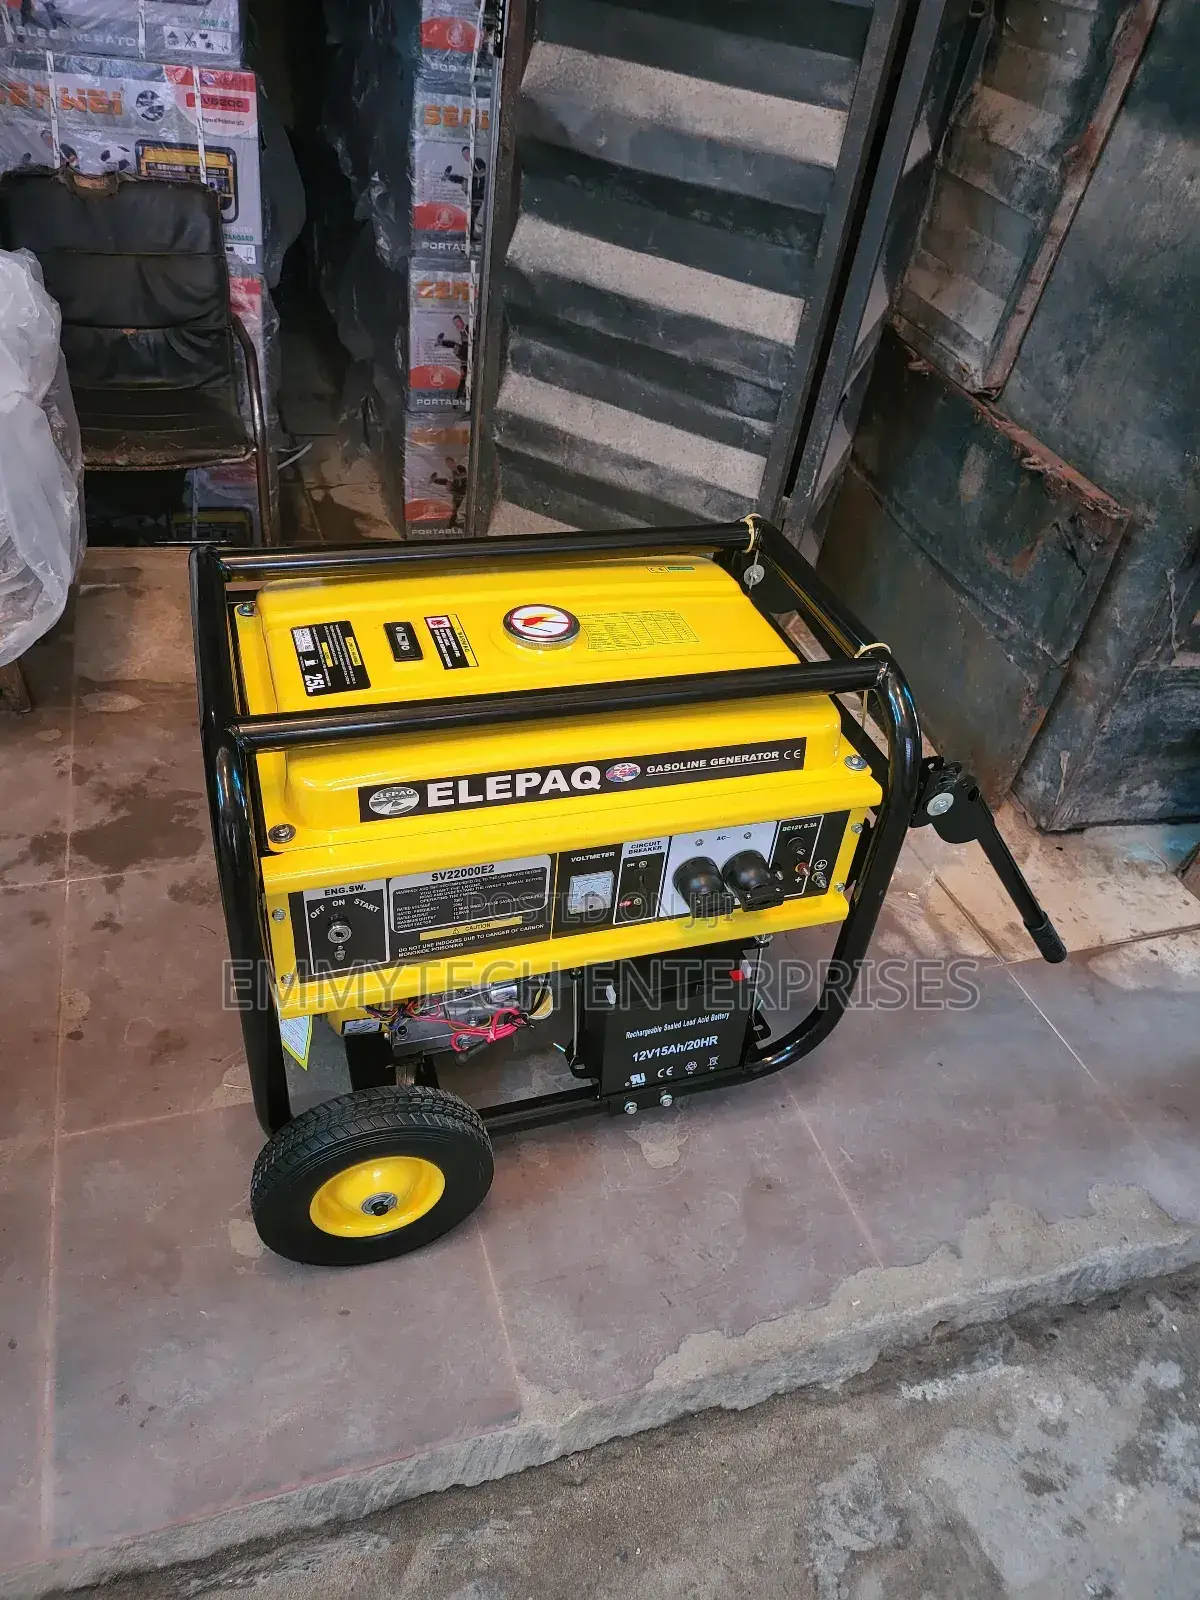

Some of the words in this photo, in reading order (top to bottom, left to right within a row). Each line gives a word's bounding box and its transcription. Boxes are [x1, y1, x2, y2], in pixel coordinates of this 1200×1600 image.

[416, 399, 467, 407] PORTABL
[304, 673, 326, 693] 25L
[426, 765, 601, 808] ELEPAQ
[646, 759, 707, 774] GASOLINE
[710, 750, 780, 766] GENERATOR
[628, 845, 663, 855] BREAKER
[630, 840, 662, 849] CIRCUIT
[571, 851, 616, 863] VOLTMETER
[431, 864, 495, 882] SV22000E2
[324, 883, 367, 896] ENG.SW.
[332, 899, 346, 907] ON
[353, 897, 381, 913] START
[310, 904, 326, 919] OFF
[465, 922, 491, 932] CAUTION
[435, 938, 462, 947] INDOORS
[625, 1025, 662, 1040] Rechargeable
[663, 1020, 682, 1031] Sealed
[683, 1018, 696, 1028] Lead
[697, 1014, 710, 1025] Acid
[710, 1012, 730, 1024] Battery
[632, 1035, 719, 1063] 12V15Ah/20HR
